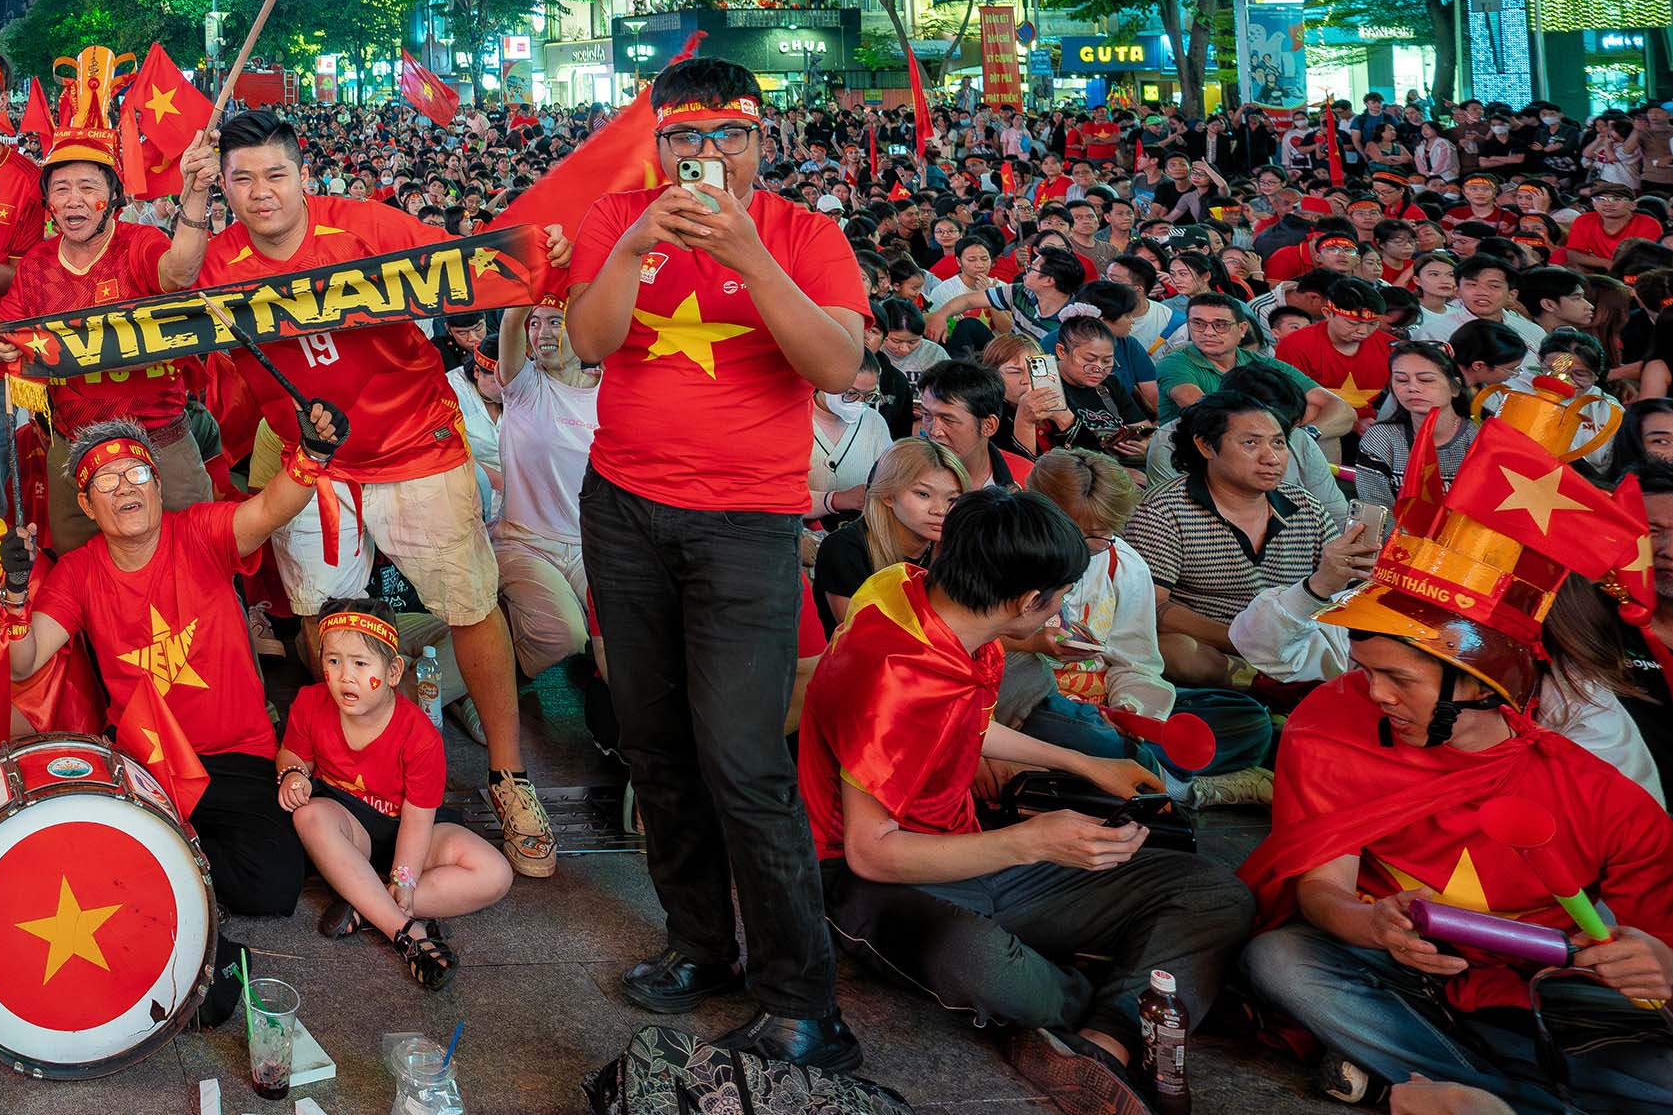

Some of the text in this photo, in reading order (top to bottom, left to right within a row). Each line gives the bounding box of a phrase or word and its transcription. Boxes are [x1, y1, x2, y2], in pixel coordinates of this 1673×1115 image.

[779, 39, 827, 53] CHUA
[1079, 44, 1144, 63] GUTA
[47, 248, 469, 367] VIETNAM
[299, 331, 340, 368] 19
[1402, 576, 1451, 604] THẮNG
[327, 617, 347, 627] NAM
[360, 619, 388, 636] CHIẾN
